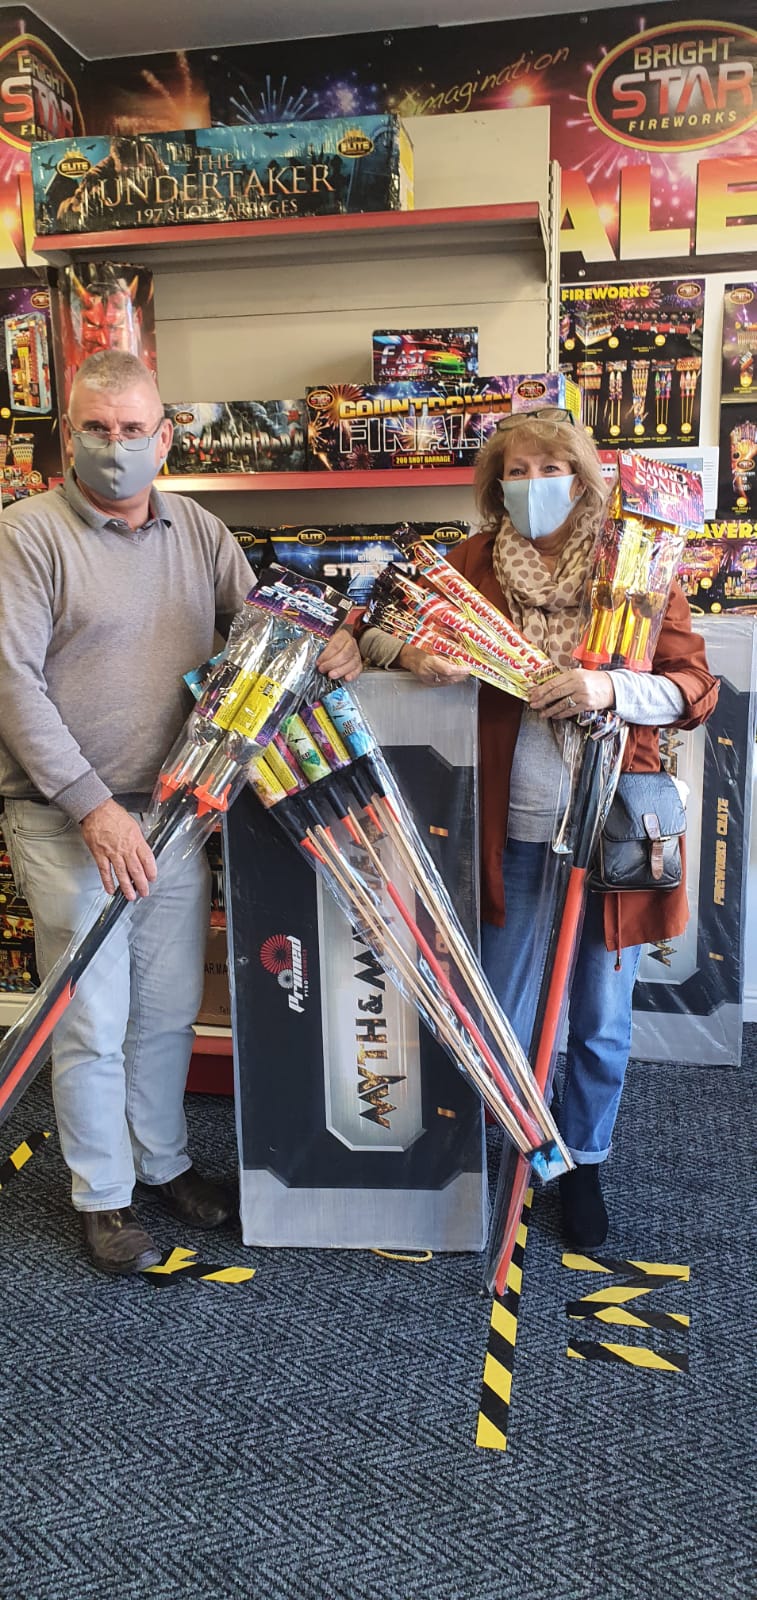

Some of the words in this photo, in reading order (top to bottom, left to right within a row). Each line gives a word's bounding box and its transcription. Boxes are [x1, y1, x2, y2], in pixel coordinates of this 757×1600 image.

[634, 37, 735, 71] BRIGHT
[612, 61, 754, 119] STAR
[628, 110, 737, 132] FIREWORKS
[341, 140, 370, 152] ELITE
[61, 161, 89, 172] ELITE
[194, 152, 234, 171] THE
[100, 164, 335, 207] UNDERTAKER
[136, 208, 163, 223] 197
[167, 203, 212, 221] SHOT
[561, 285, 650, 301] FIREWORKS
[381, 345, 427, 364] FAST
[339, 394, 512, 419] COUNTDOWN
[635, 455, 687, 484] CROWN
[635, 470, 691, 499] KINGS
[300, 533, 324, 541] ELITE
[436, 531, 461, 540] ELITE
[286, 935, 305, 1013] Primed
[357, 994, 384, 1015] &
[354, 1018, 407, 1130] MYTH
